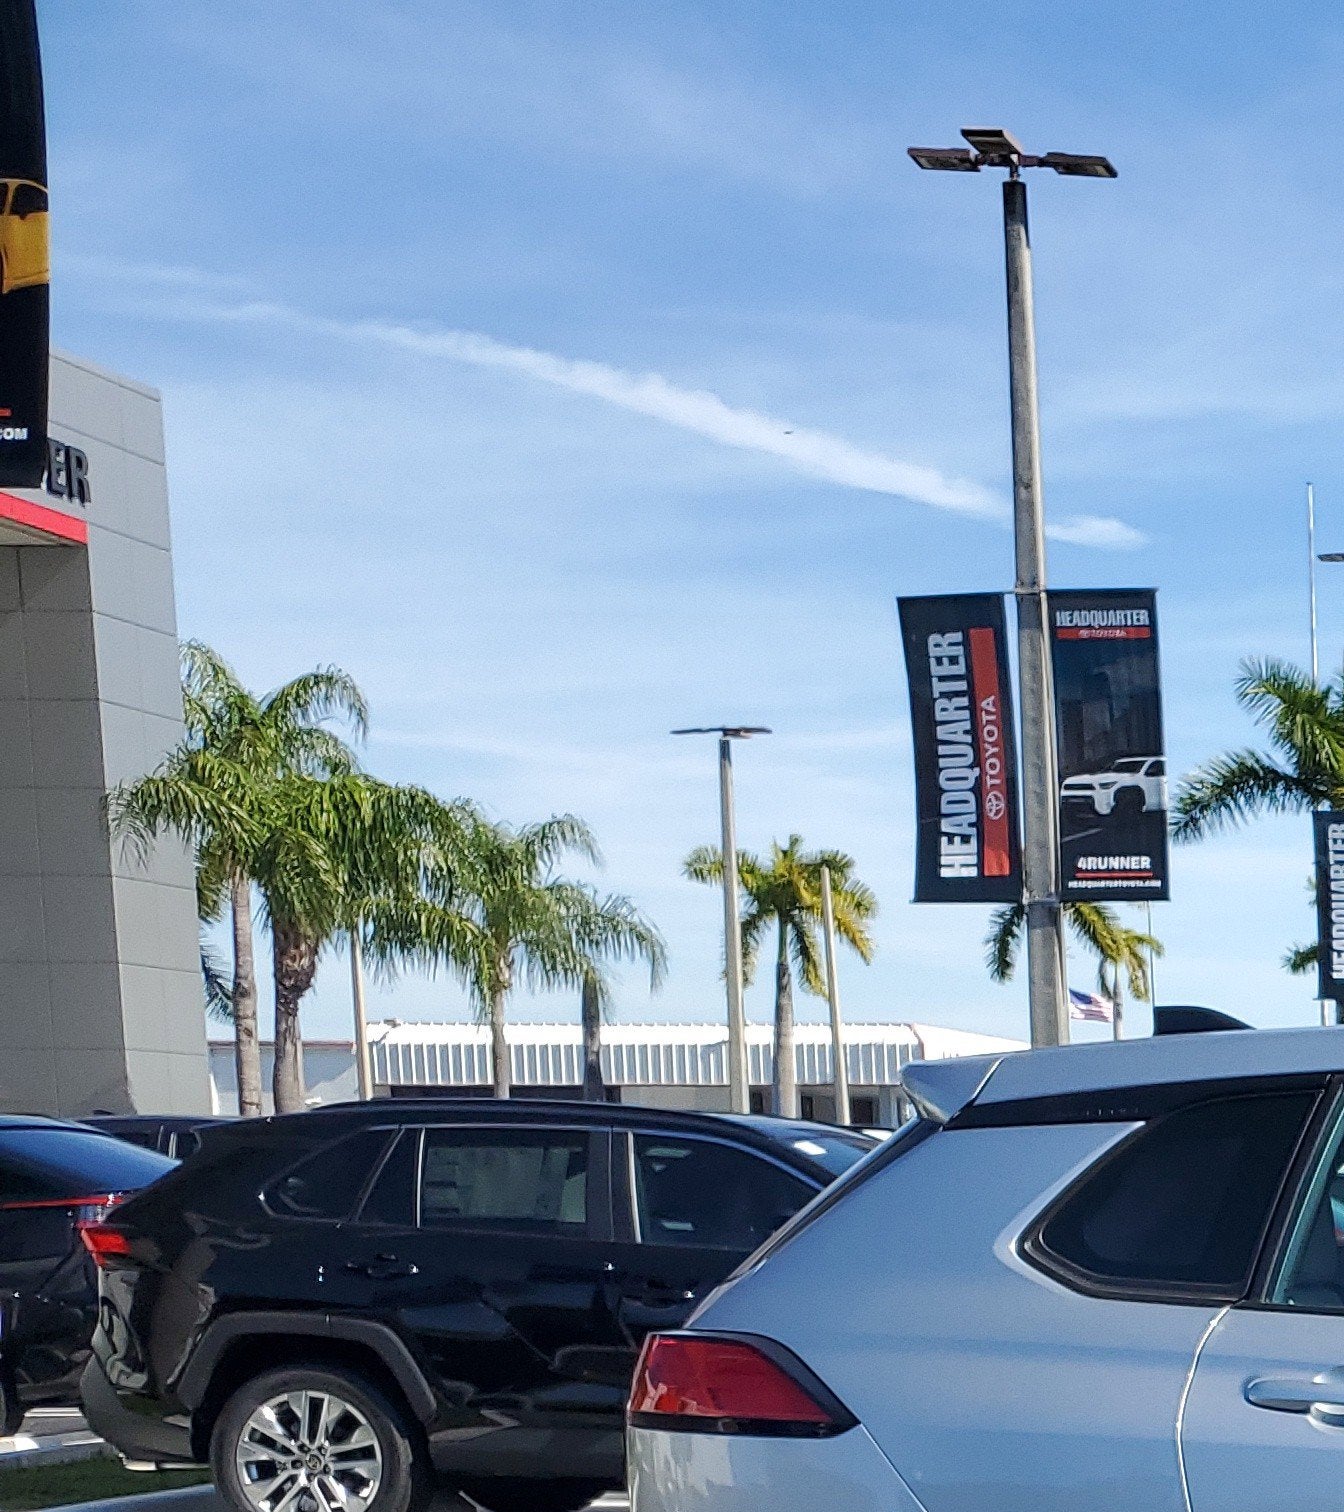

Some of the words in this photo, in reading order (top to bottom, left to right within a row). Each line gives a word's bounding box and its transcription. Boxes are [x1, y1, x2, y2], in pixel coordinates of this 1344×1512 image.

[1056, 610, 1149, 628] HEADQUARTER
[927, 631, 980, 878] HEADQUARTER
[982, 695, 1003, 788] TOYOTA
[1077, 855, 1151, 869] 4RUNNER
